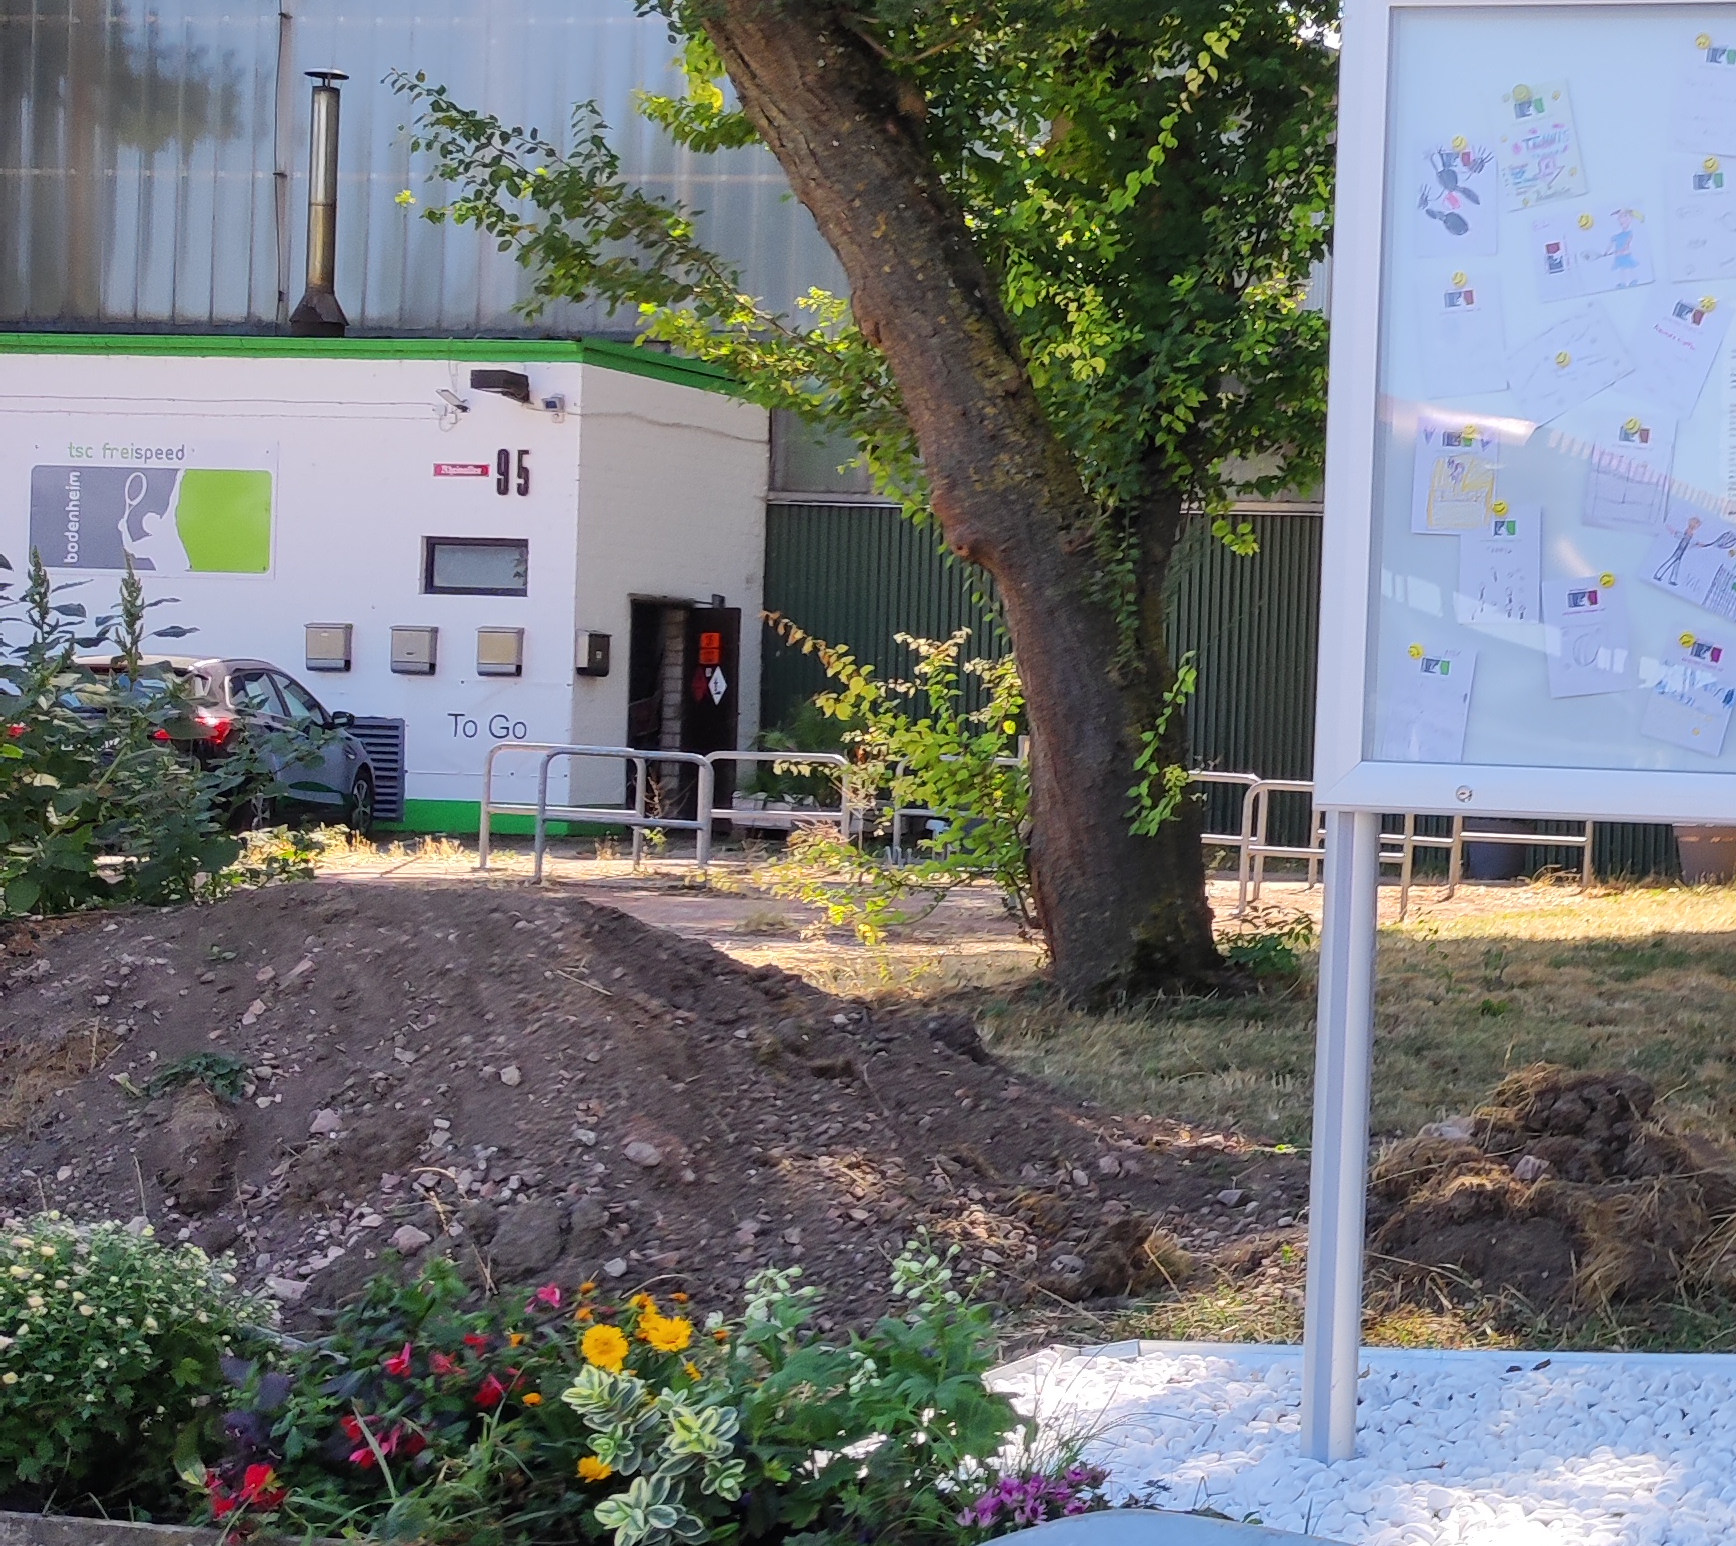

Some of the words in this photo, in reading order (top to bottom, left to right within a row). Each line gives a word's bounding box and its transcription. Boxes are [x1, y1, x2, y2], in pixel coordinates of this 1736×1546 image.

[68, 442, 93, 459] tsc
[102, 442, 185, 464] freispeed
[496, 448, 531, 496] 95
[64, 471, 81, 563] bodenheim
[447, 713, 478, 739] To
[489, 714, 527, 740] Go
